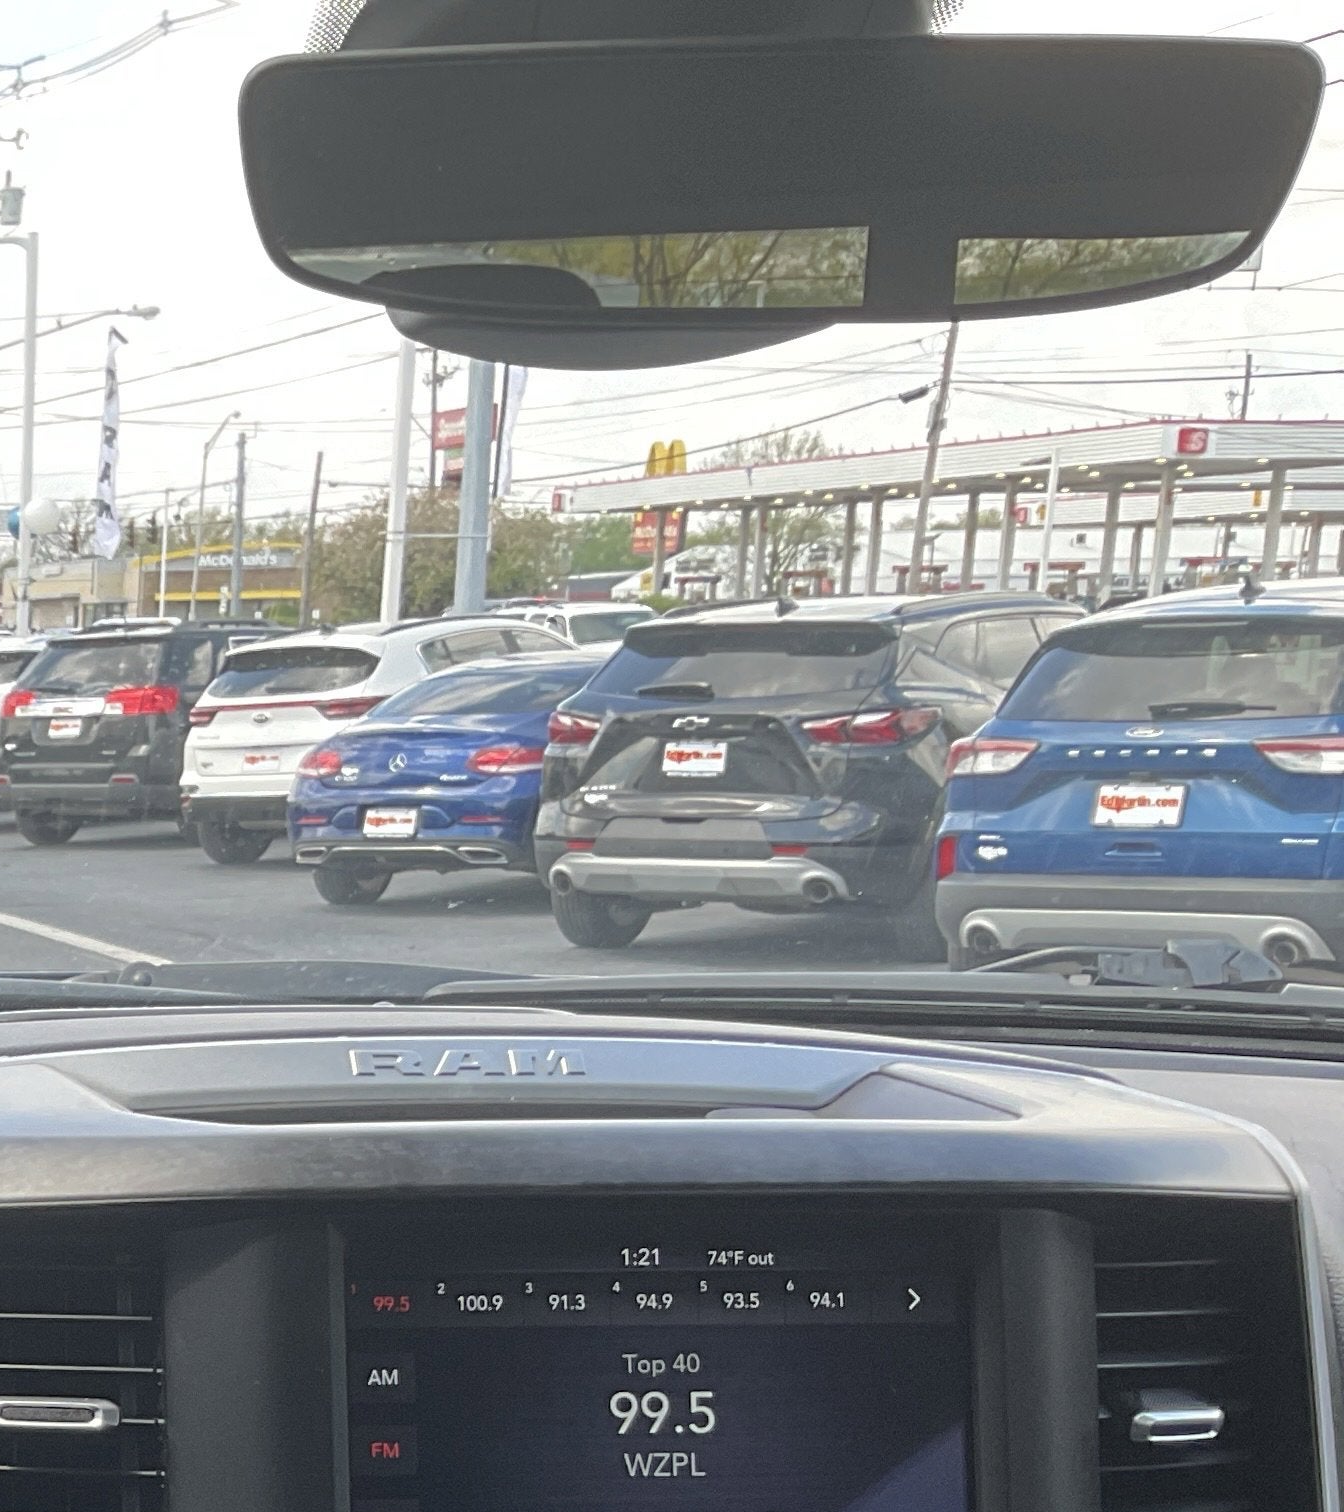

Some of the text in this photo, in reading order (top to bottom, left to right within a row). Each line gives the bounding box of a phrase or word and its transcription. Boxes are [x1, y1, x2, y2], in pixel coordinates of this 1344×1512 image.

[348, 1049, 587, 1076] RAM
[620, 1247, 774, 1267] 1:21 74°F out
[372, 1295, 410, 1313] 99.5
[437, 1283, 503, 1312] 2 100.9
[525, 1282, 586, 1311] 3 91.3
[612, 1281, 673, 1310] 4 94.9
[699, 1280, 760, 1309] 5 93.5
[786, 1280, 845, 1308] 6 94.1
[367, 1369, 399, 1386] AM
[622, 1352, 701, 1378] Top 40
[609, 1390, 716, 1435] 99.5
[370, 1442, 400, 1459] FM
[624, 1452, 707, 1478] WZPL
